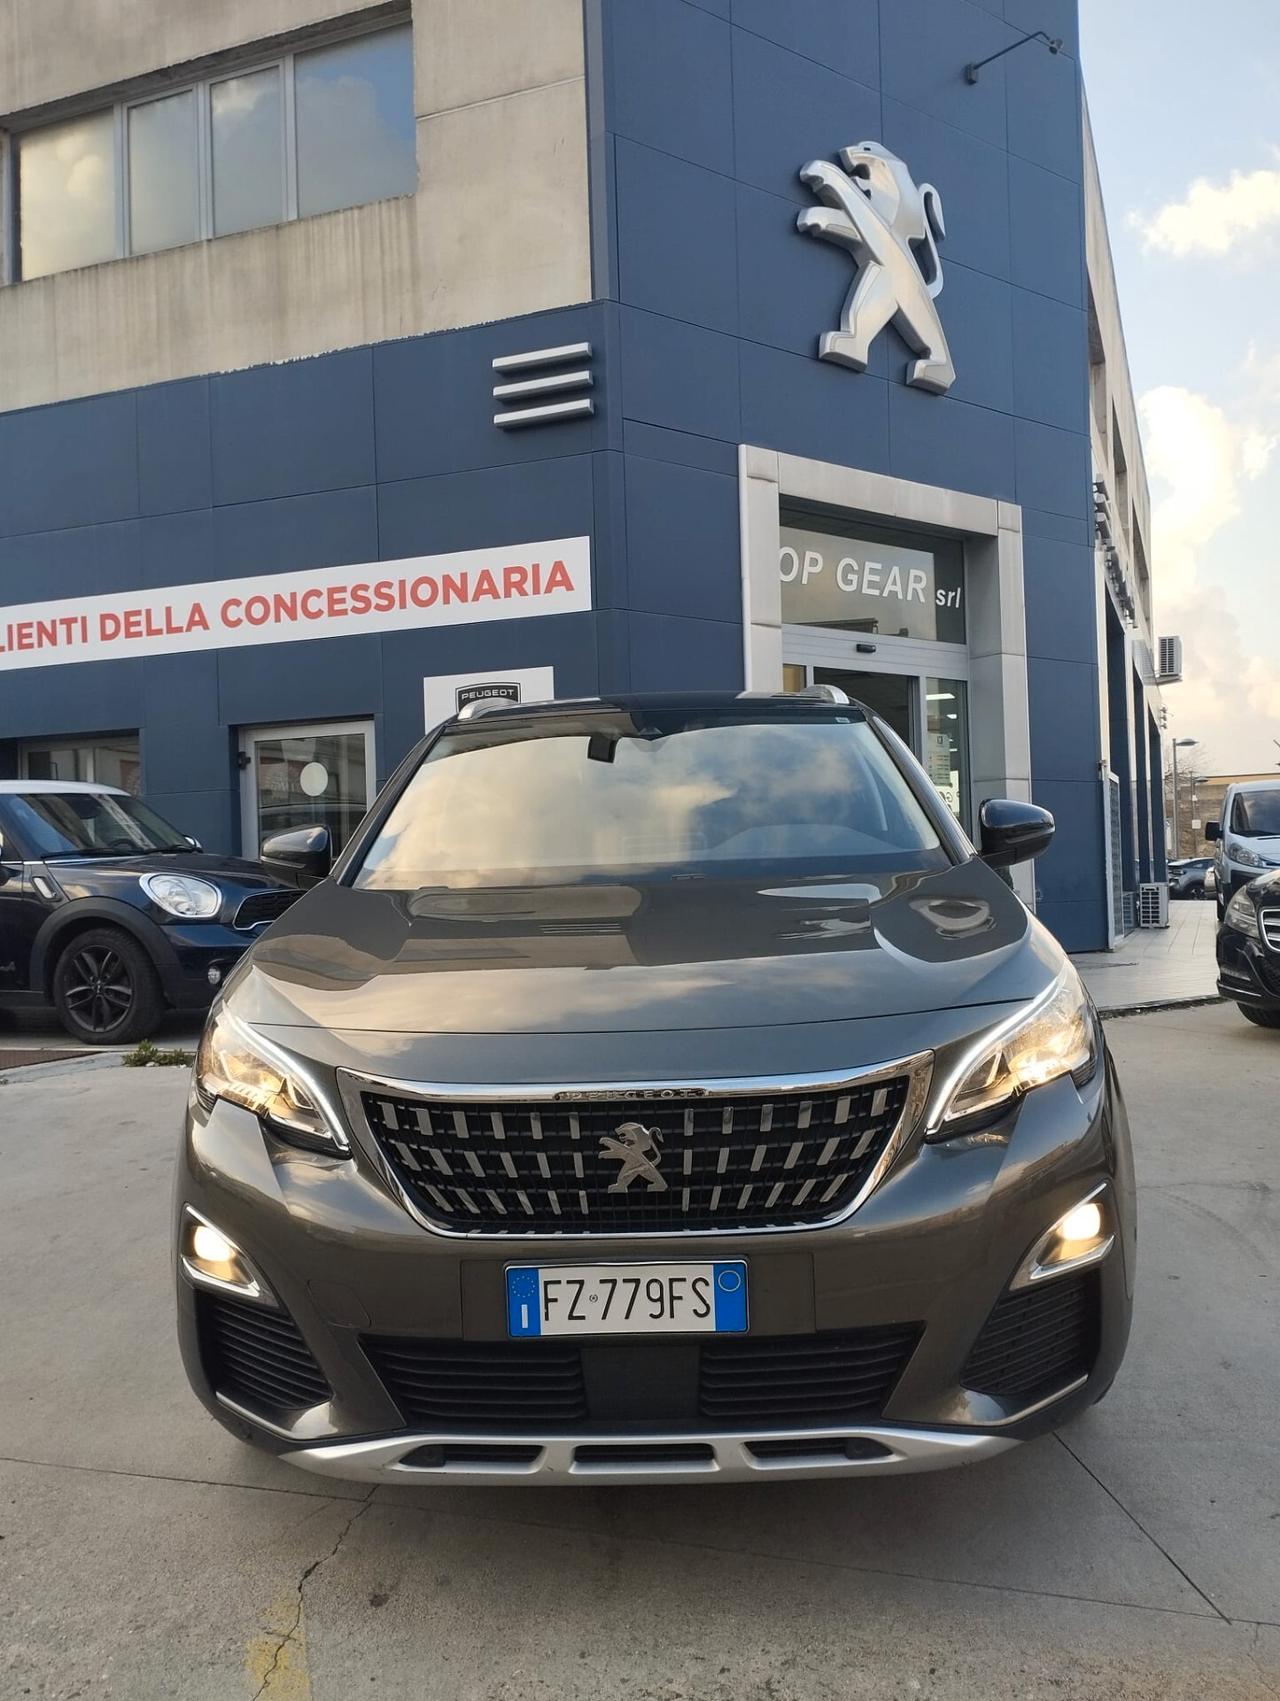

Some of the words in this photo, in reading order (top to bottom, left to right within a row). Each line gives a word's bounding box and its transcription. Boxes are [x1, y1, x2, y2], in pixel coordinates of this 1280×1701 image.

[99, 602, 209, 642] DELLA
[220, 560, 575, 628] CONCESSIONARIA
[836, 557, 928, 603] GEAR
[936, 587, 961, 609] srl
[461, 689, 515, 700] PEUGEOT
